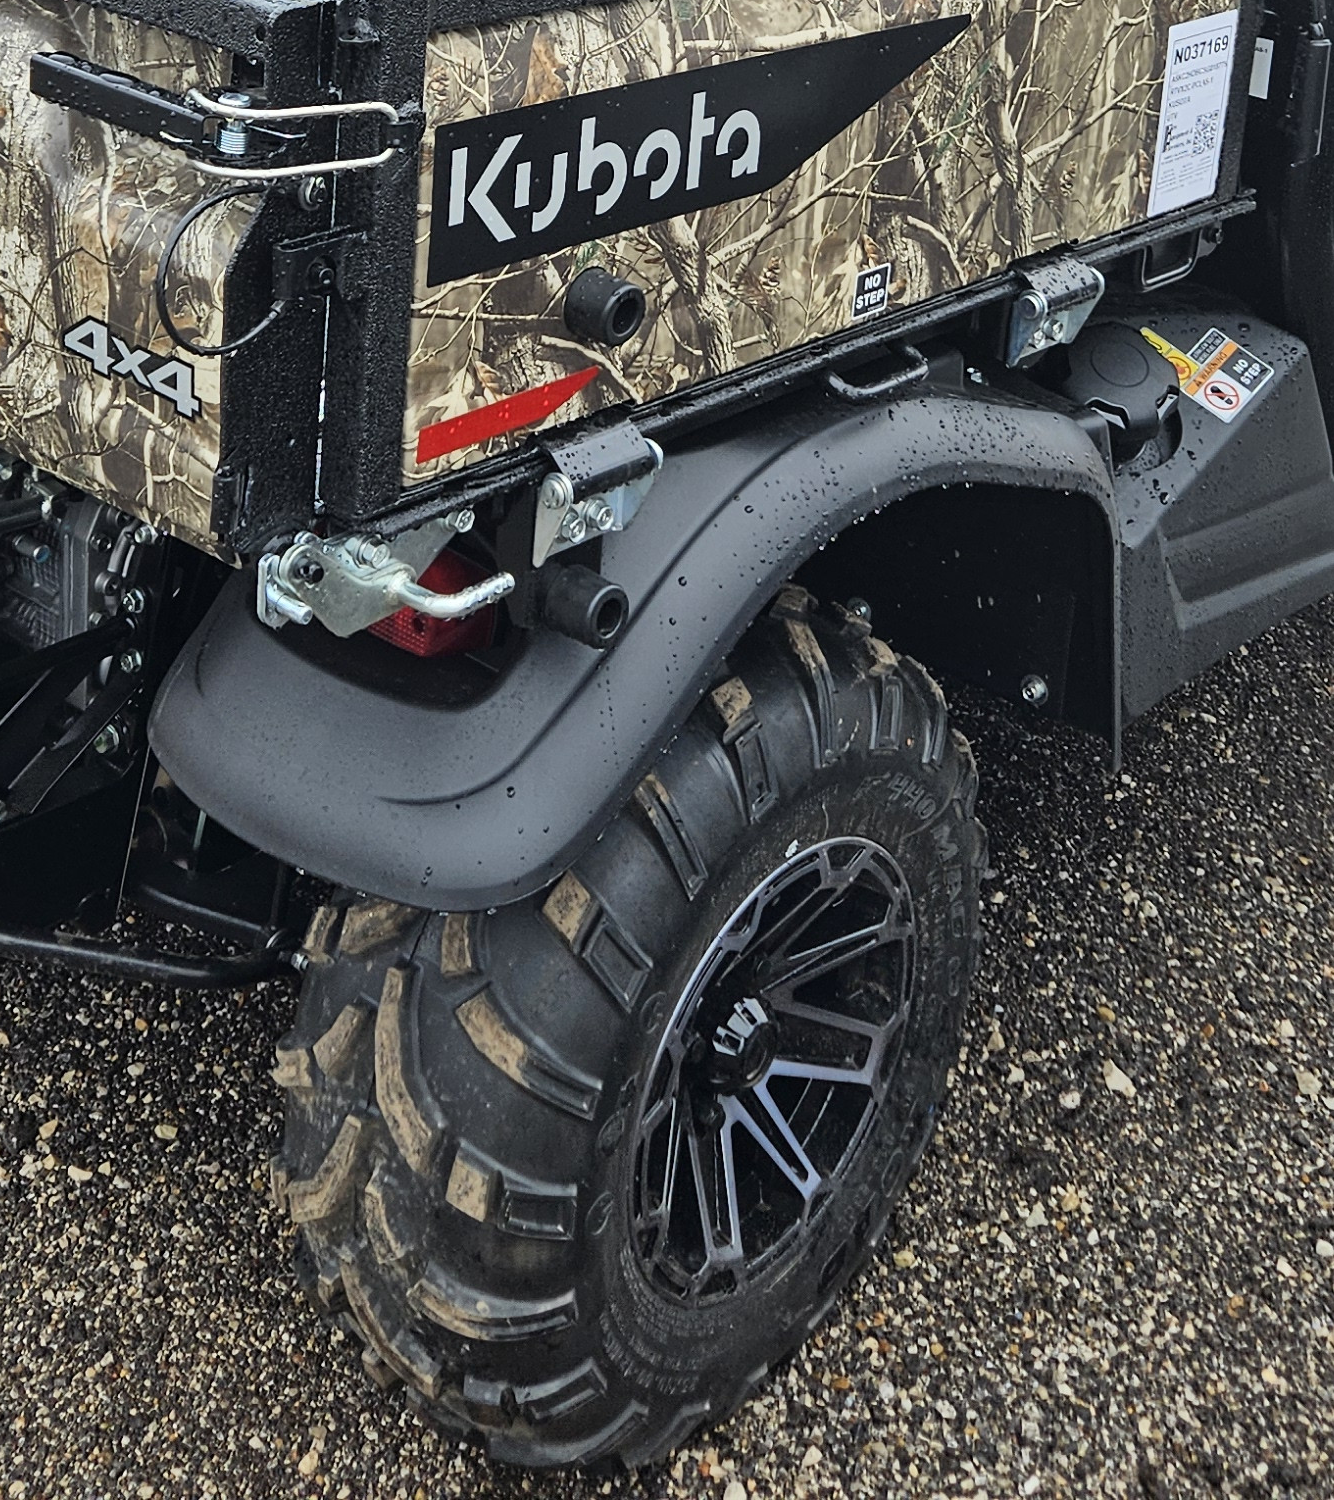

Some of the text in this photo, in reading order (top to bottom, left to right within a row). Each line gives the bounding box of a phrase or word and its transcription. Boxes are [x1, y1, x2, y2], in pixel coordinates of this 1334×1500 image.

[1173, 34, 1229, 66] N037169
[448, 90, 761, 243] Kubota
[864, 273, 882, 290] NO
[855, 287, 885, 310] STEP
[1201, 352, 1227, 379] WARNING
[1232, 358, 1249, 374] NO
[1240, 362, 1262, 385] STEP
